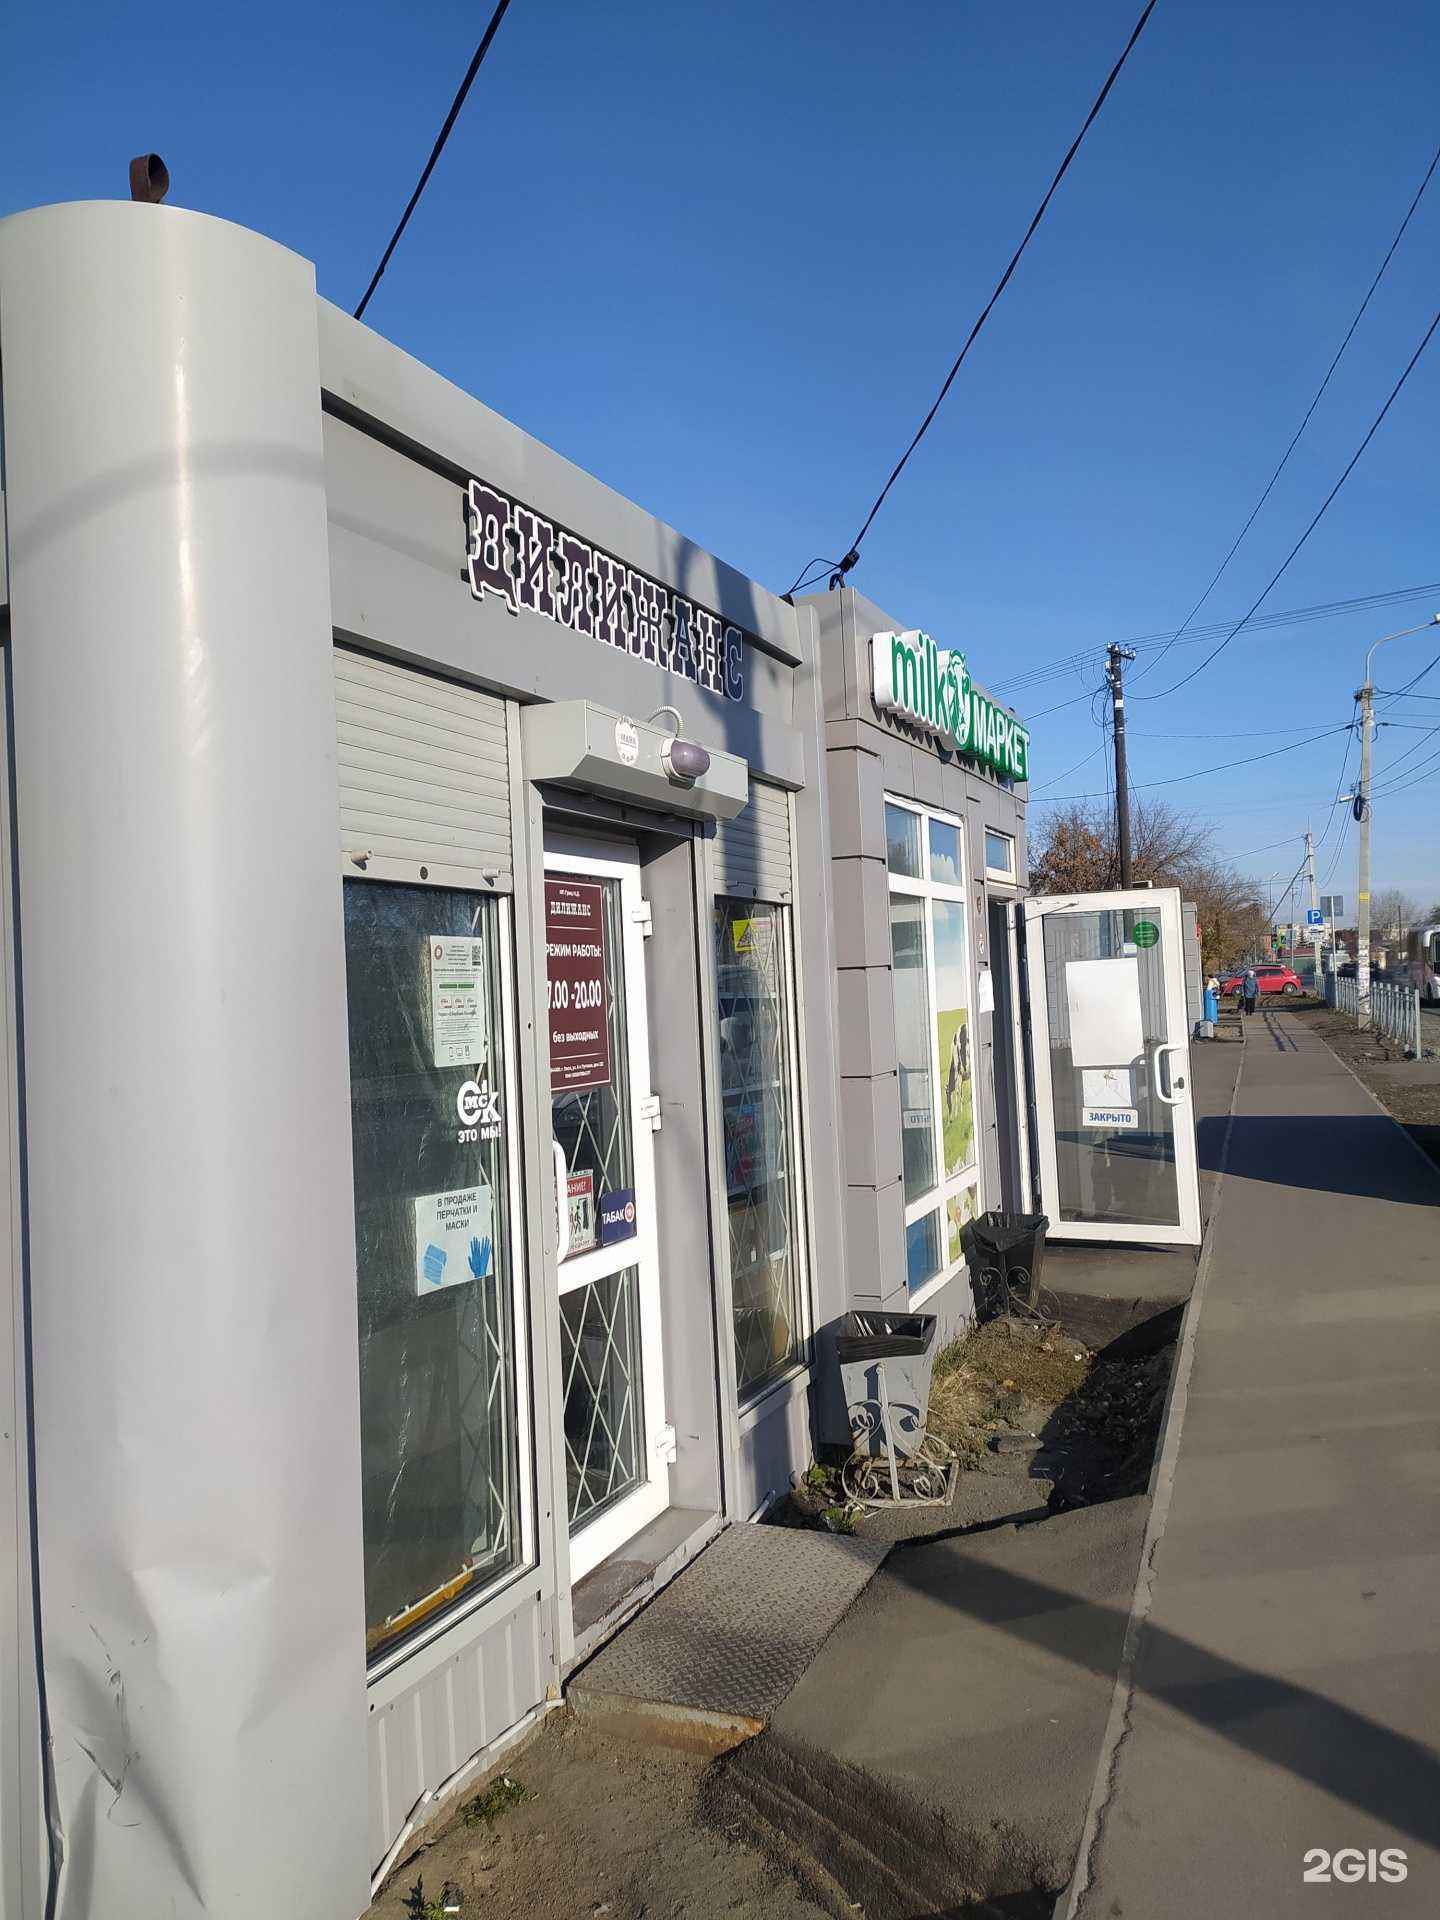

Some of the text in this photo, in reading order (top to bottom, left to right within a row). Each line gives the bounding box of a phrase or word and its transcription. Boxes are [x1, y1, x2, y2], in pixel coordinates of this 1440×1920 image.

[467, 479, 744, 702] ДИЛИЖАНС
[890, 631, 951, 732] milk
[545, 943, 602, 957] РЕЖИМ РАБОТЫ:
[552, 1030, 599, 1043] без выходных
[1088, 1111, 1132, 1124] ЗАКРЫТО
[457, 1122, 502, 1144] ЭТО МЫ!
[437, 1192, 478, 1208] В ПРОДАЖЕ
[436, 1204, 478, 1221] ПЕРЧАТКИ И
[601, 1208, 625, 1225] ТАБАК
[445, 1218, 470, 1233] МАСКИ
